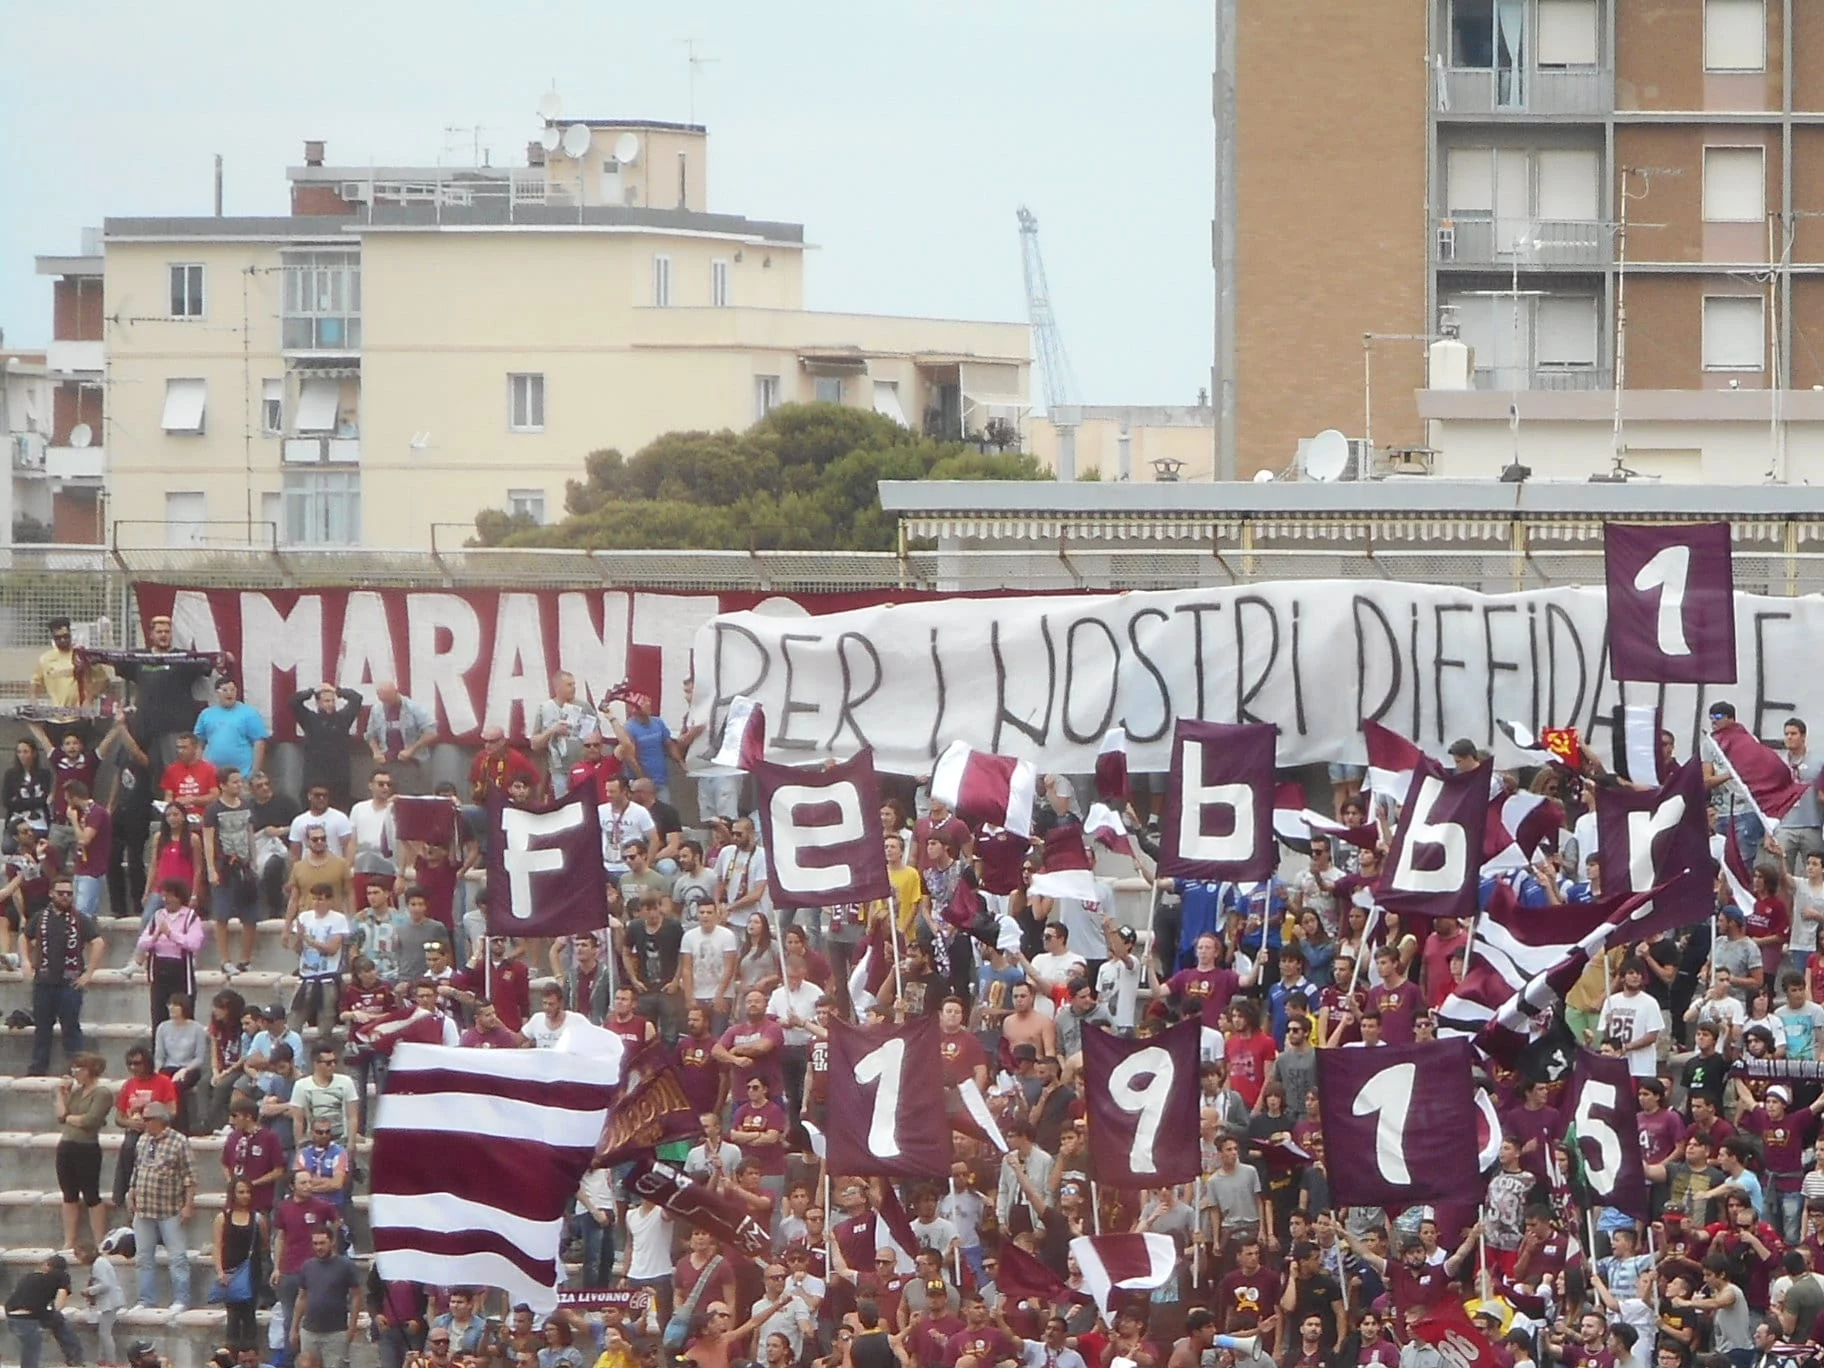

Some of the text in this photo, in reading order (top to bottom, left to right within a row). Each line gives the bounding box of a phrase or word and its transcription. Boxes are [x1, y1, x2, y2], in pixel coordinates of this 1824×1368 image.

[1634, 545, 1691, 656] 1
[170, 590, 812, 742] AMARANT
[704, 621, 884, 761] PER
[502, 801, 585, 919] F
[1177, 740, 1256, 861] b
[1107, 1046, 1175, 1175] 9
[1575, 1079, 1624, 1197] 5
[578, 1292, 631, 1303] LIVORNO
